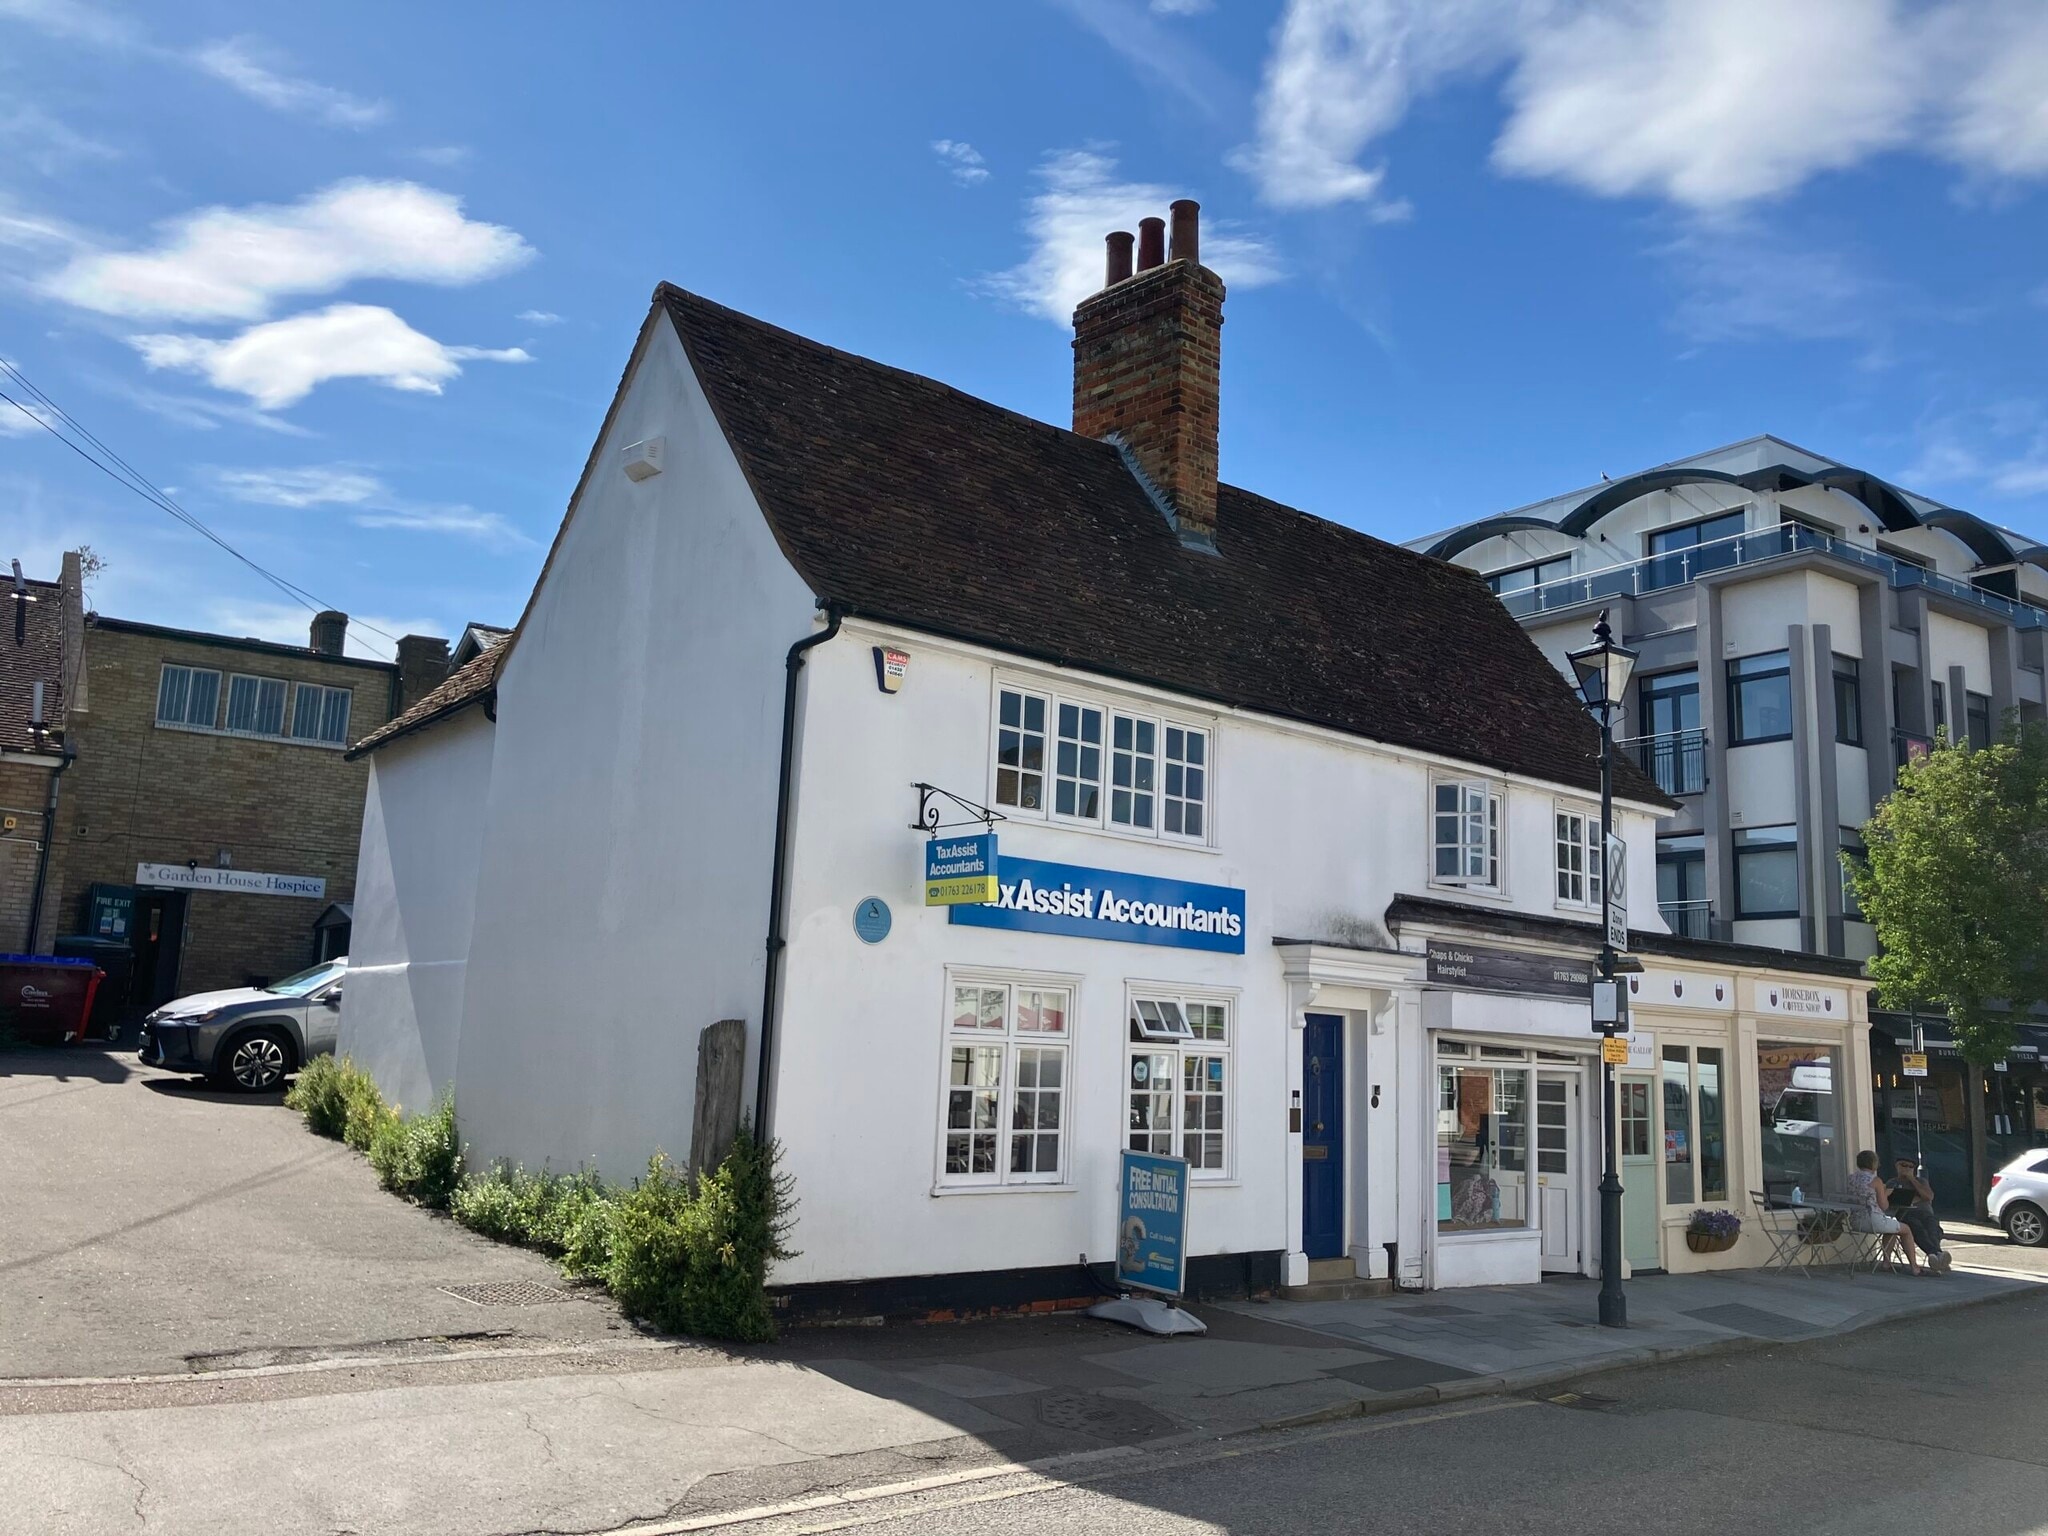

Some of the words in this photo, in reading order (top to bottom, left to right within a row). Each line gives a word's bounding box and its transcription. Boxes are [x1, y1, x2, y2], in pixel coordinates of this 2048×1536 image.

[887, 652, 907, 663] CAMS
[936, 842, 978, 860] TaxAssist
[930, 858, 985, 876] Accountants
[158, 867, 212, 884] Garden
[217, 872, 263, 888] House
[267, 877, 321, 893] Hospice
[940, 885, 960, 897] 01763
[961, 883, 986, 895] 226178
[96, 896, 113, 906] FIRE
[114, 898, 132, 909] EXIT
[1097, 889, 1241, 937] Accountants
[1612, 911, 1623, 926] Zone
[1611, 926, 1625, 945] ENDS
[1448, 951, 1453, 961] &
[1454, 951, 1474, 963] Chicks
[1437, 964, 1467, 978] Hairstylist
[1553, 970, 1569, 982] 01763
[1782, 987, 1820, 1002] HORSEBOX
[1782, 1001, 1805, 1012] COFFEE
[1805, 1003, 1820, 1013] SHOP
[1130, 1165, 1152, 1191] FREE
[1152, 1174, 1178, 1195] INITIAL
[1129, 1191, 1178, 1213] CONSULTATION
